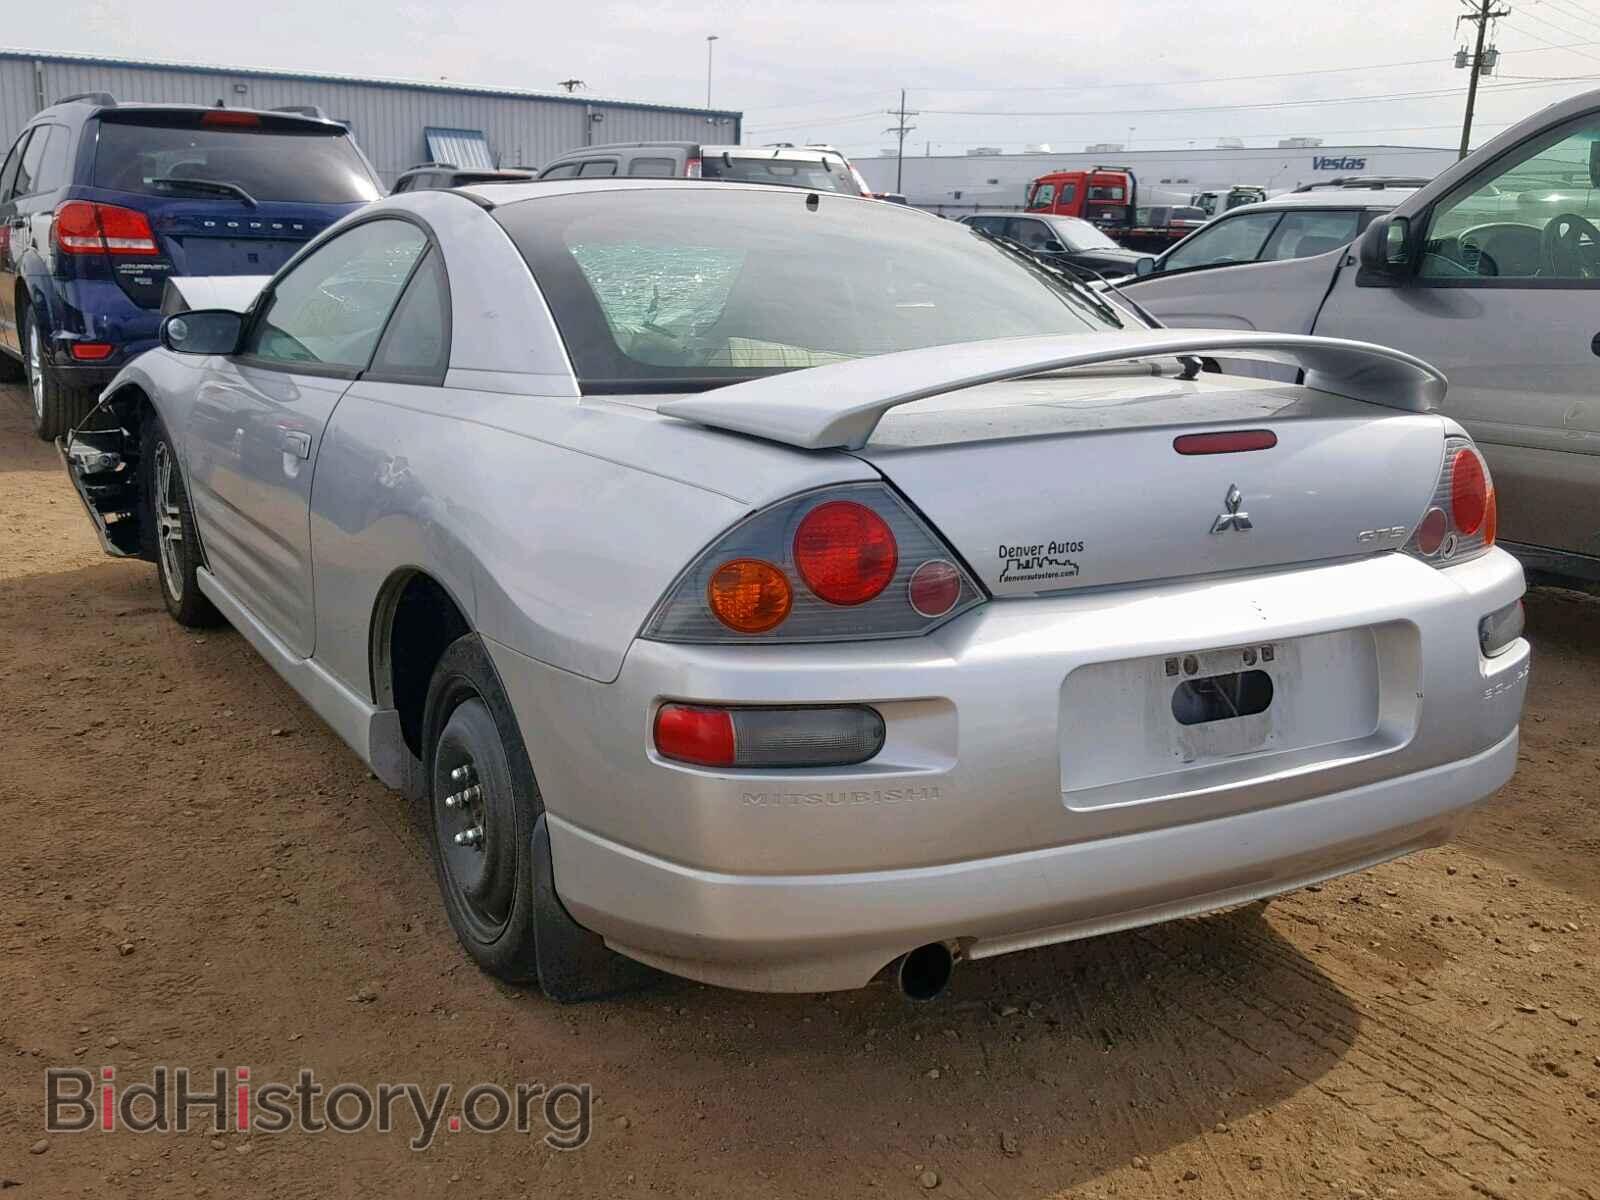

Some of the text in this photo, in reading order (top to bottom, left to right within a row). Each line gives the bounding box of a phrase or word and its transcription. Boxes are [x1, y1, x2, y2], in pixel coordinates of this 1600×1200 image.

[1312, 155, 1367, 171] Vestas
[203, 220, 304, 231] DODGE
[1357, 526, 1405, 542] GTS
[998, 540, 1085, 559] Denver Autos
[742, 784, 942, 808] MITSUBISHI
